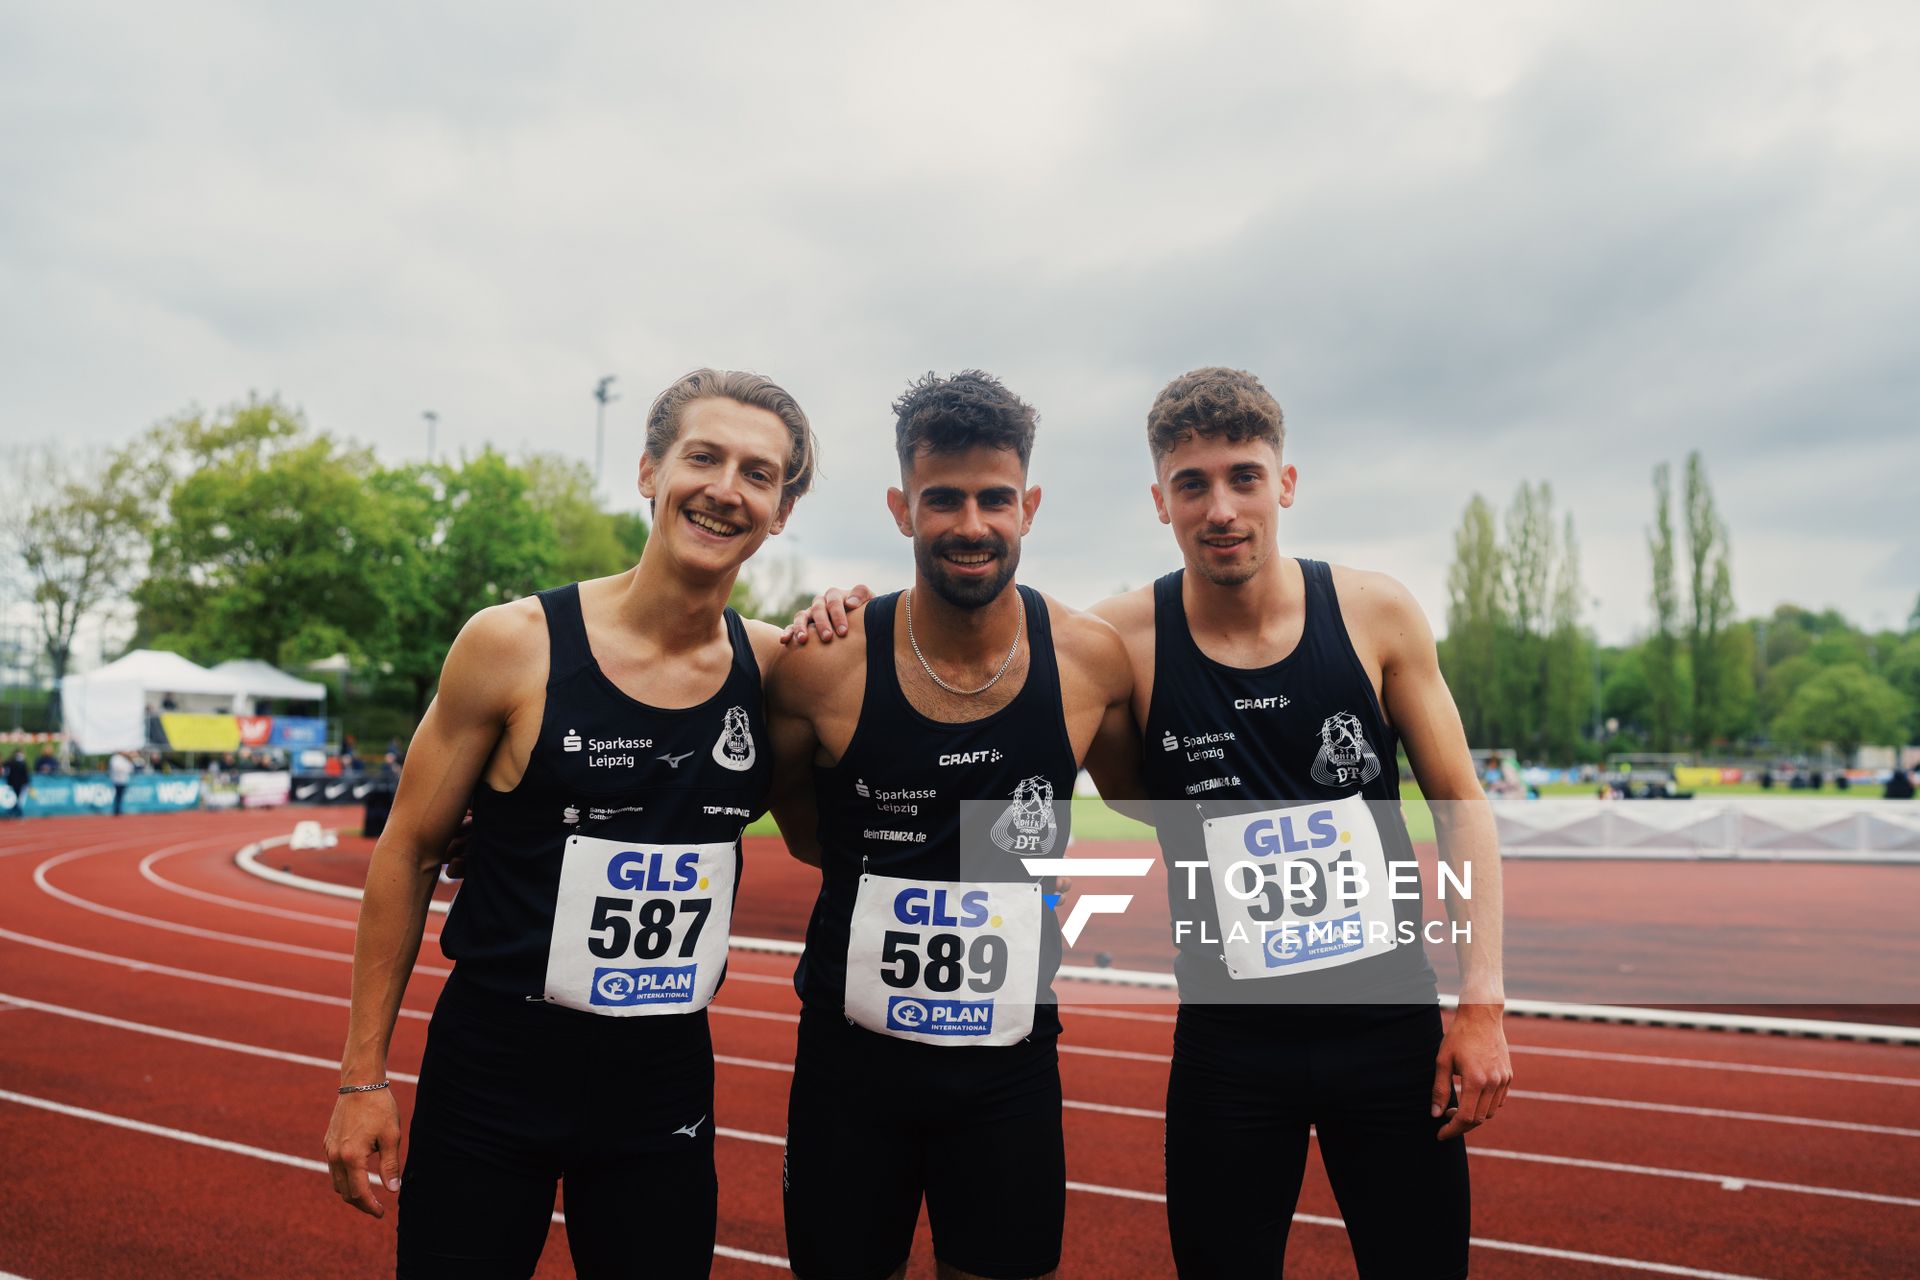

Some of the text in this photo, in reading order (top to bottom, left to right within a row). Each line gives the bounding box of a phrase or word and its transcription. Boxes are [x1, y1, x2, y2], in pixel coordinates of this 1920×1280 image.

[1235, 697, 1278, 710] CRAFT
[588, 737, 653, 753] Sparkasse
[1183, 731, 1236, 748] Sparkasse
[589, 754, 635, 769] Leipzig
[939, 750, 989, 766] CRAFT
[1187, 747, 1224, 763] Leipzig
[1336, 767, 1359, 783] DT
[875, 788, 937, 802] Sparkasse
[877, 803, 918, 816] Leipzig
[863, 829, 927, 843] deinTEAM24.de
[1015, 834, 1041, 851] DT
[1242, 849, 1358, 922] 591
[588, 895, 713, 960] 587
[880, 930, 1009, 994] 589
[637, 973, 692, 991] PLAN
[636, 992, 689, 1000] INTERNATIONAL
[931, 1006, 988, 1023] PLAN
